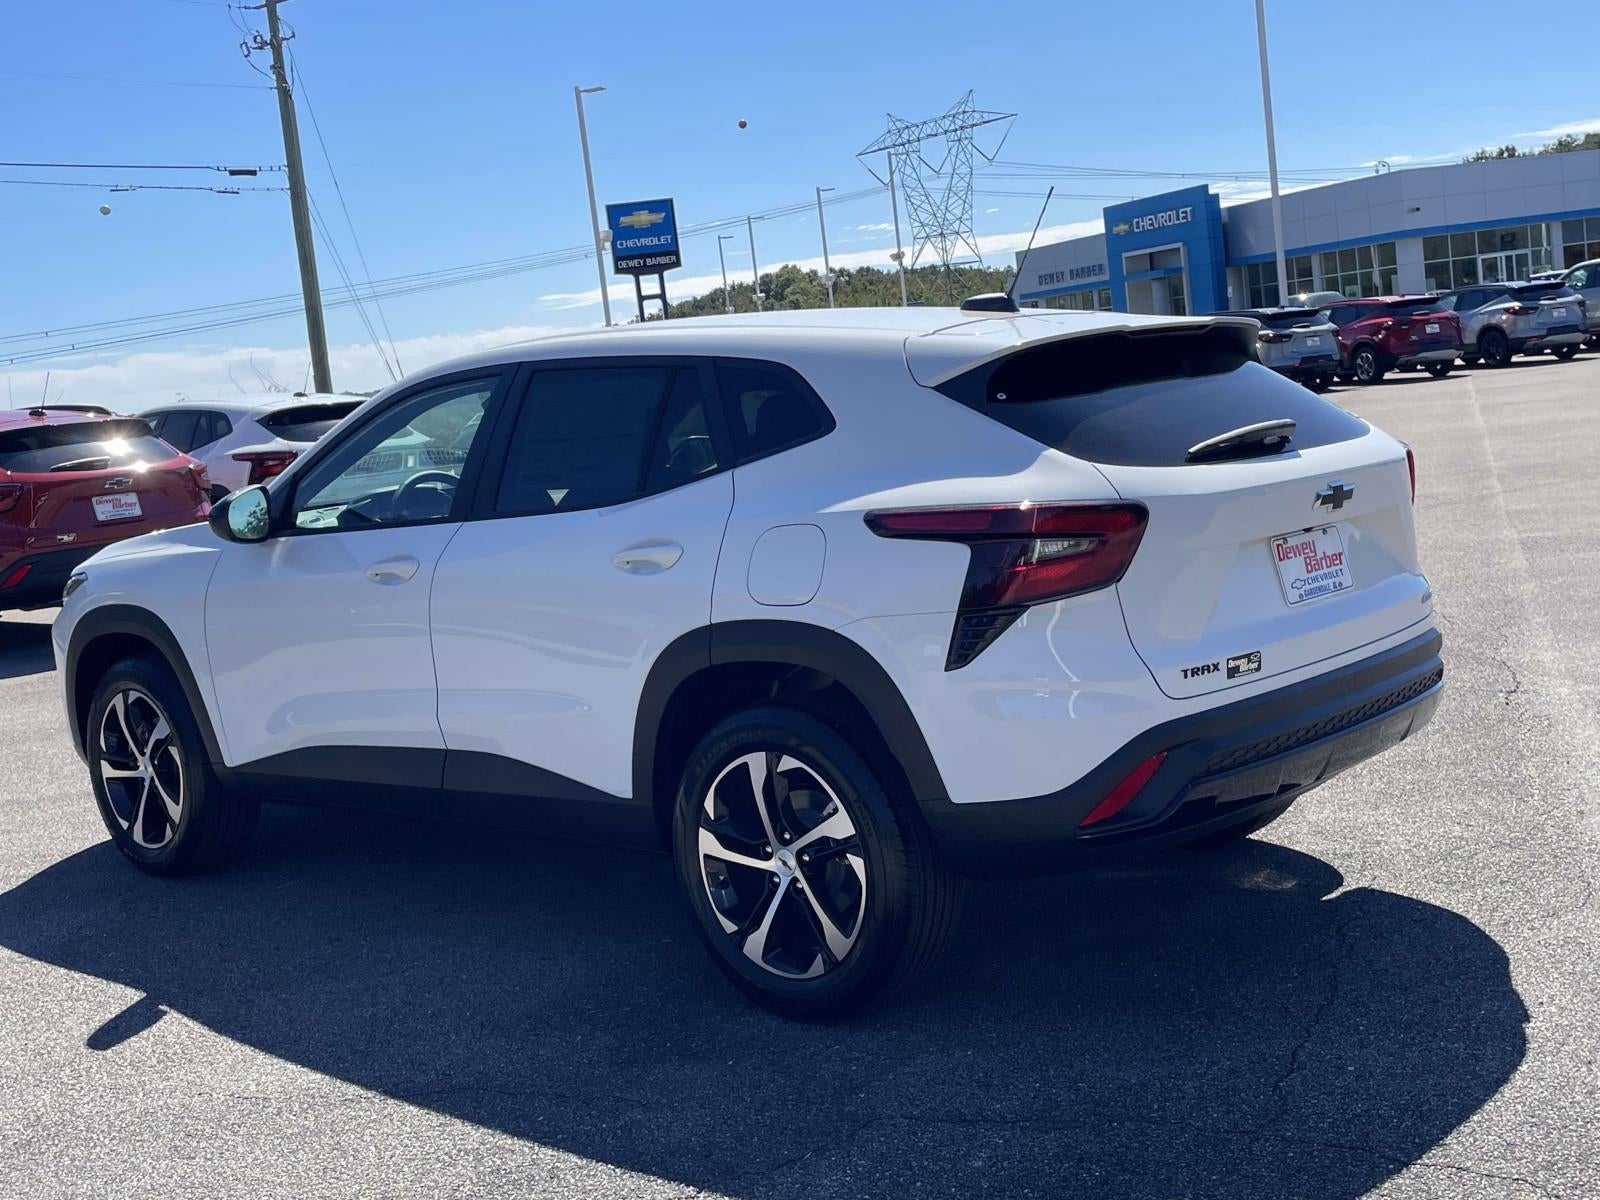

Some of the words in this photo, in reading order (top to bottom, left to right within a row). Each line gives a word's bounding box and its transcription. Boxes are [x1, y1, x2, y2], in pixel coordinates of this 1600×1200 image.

[1133, 207, 1193, 232] CHEVROLET
[617, 235, 672, 249] CHEVROLET
[618, 258, 645, 269] DEWEY
[646, 255, 677, 266] BARBER
[1038, 271, 1065, 286] DEWEY
[1069, 263, 1107, 281] BARBER
[1276, 539, 1318, 562] Dewey
[1304, 551, 1344, 574] Barber
[1306, 568, 1344, 586] CHEVROLET
[1181, 661, 1220, 680] TRAX
